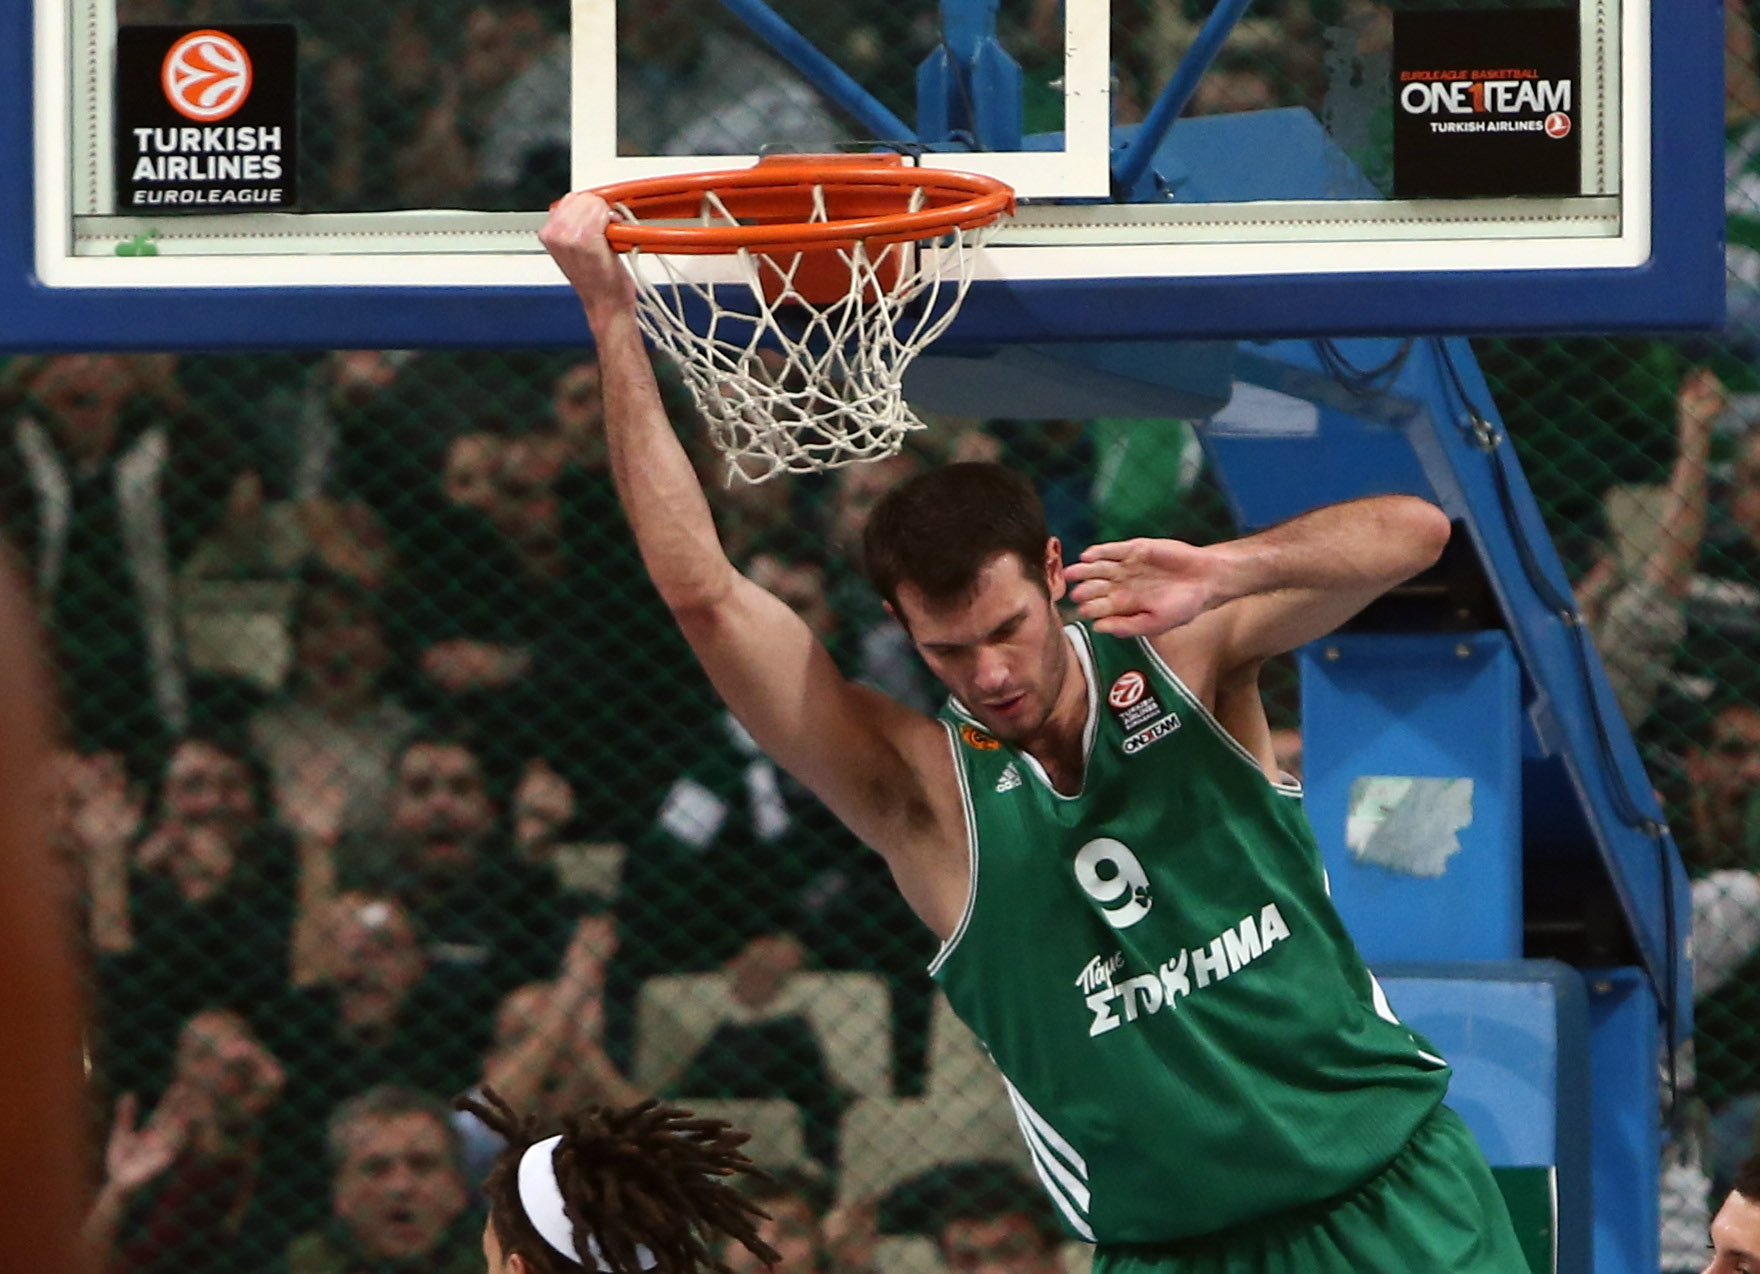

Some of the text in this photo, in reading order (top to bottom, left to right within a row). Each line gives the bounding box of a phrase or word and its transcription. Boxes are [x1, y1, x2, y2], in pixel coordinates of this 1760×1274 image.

[1400, 68, 1539, 81] EUROLEAGUE BASKETBALL
[1430, 120, 1543, 133] TURKISH AIRLINES
[133, 126, 282, 152] TURKISH
[132, 155, 283, 181] AIRLINES
[133, 188, 283, 204] EUROLEAGUE
[1074, 838, 1153, 929] 9
